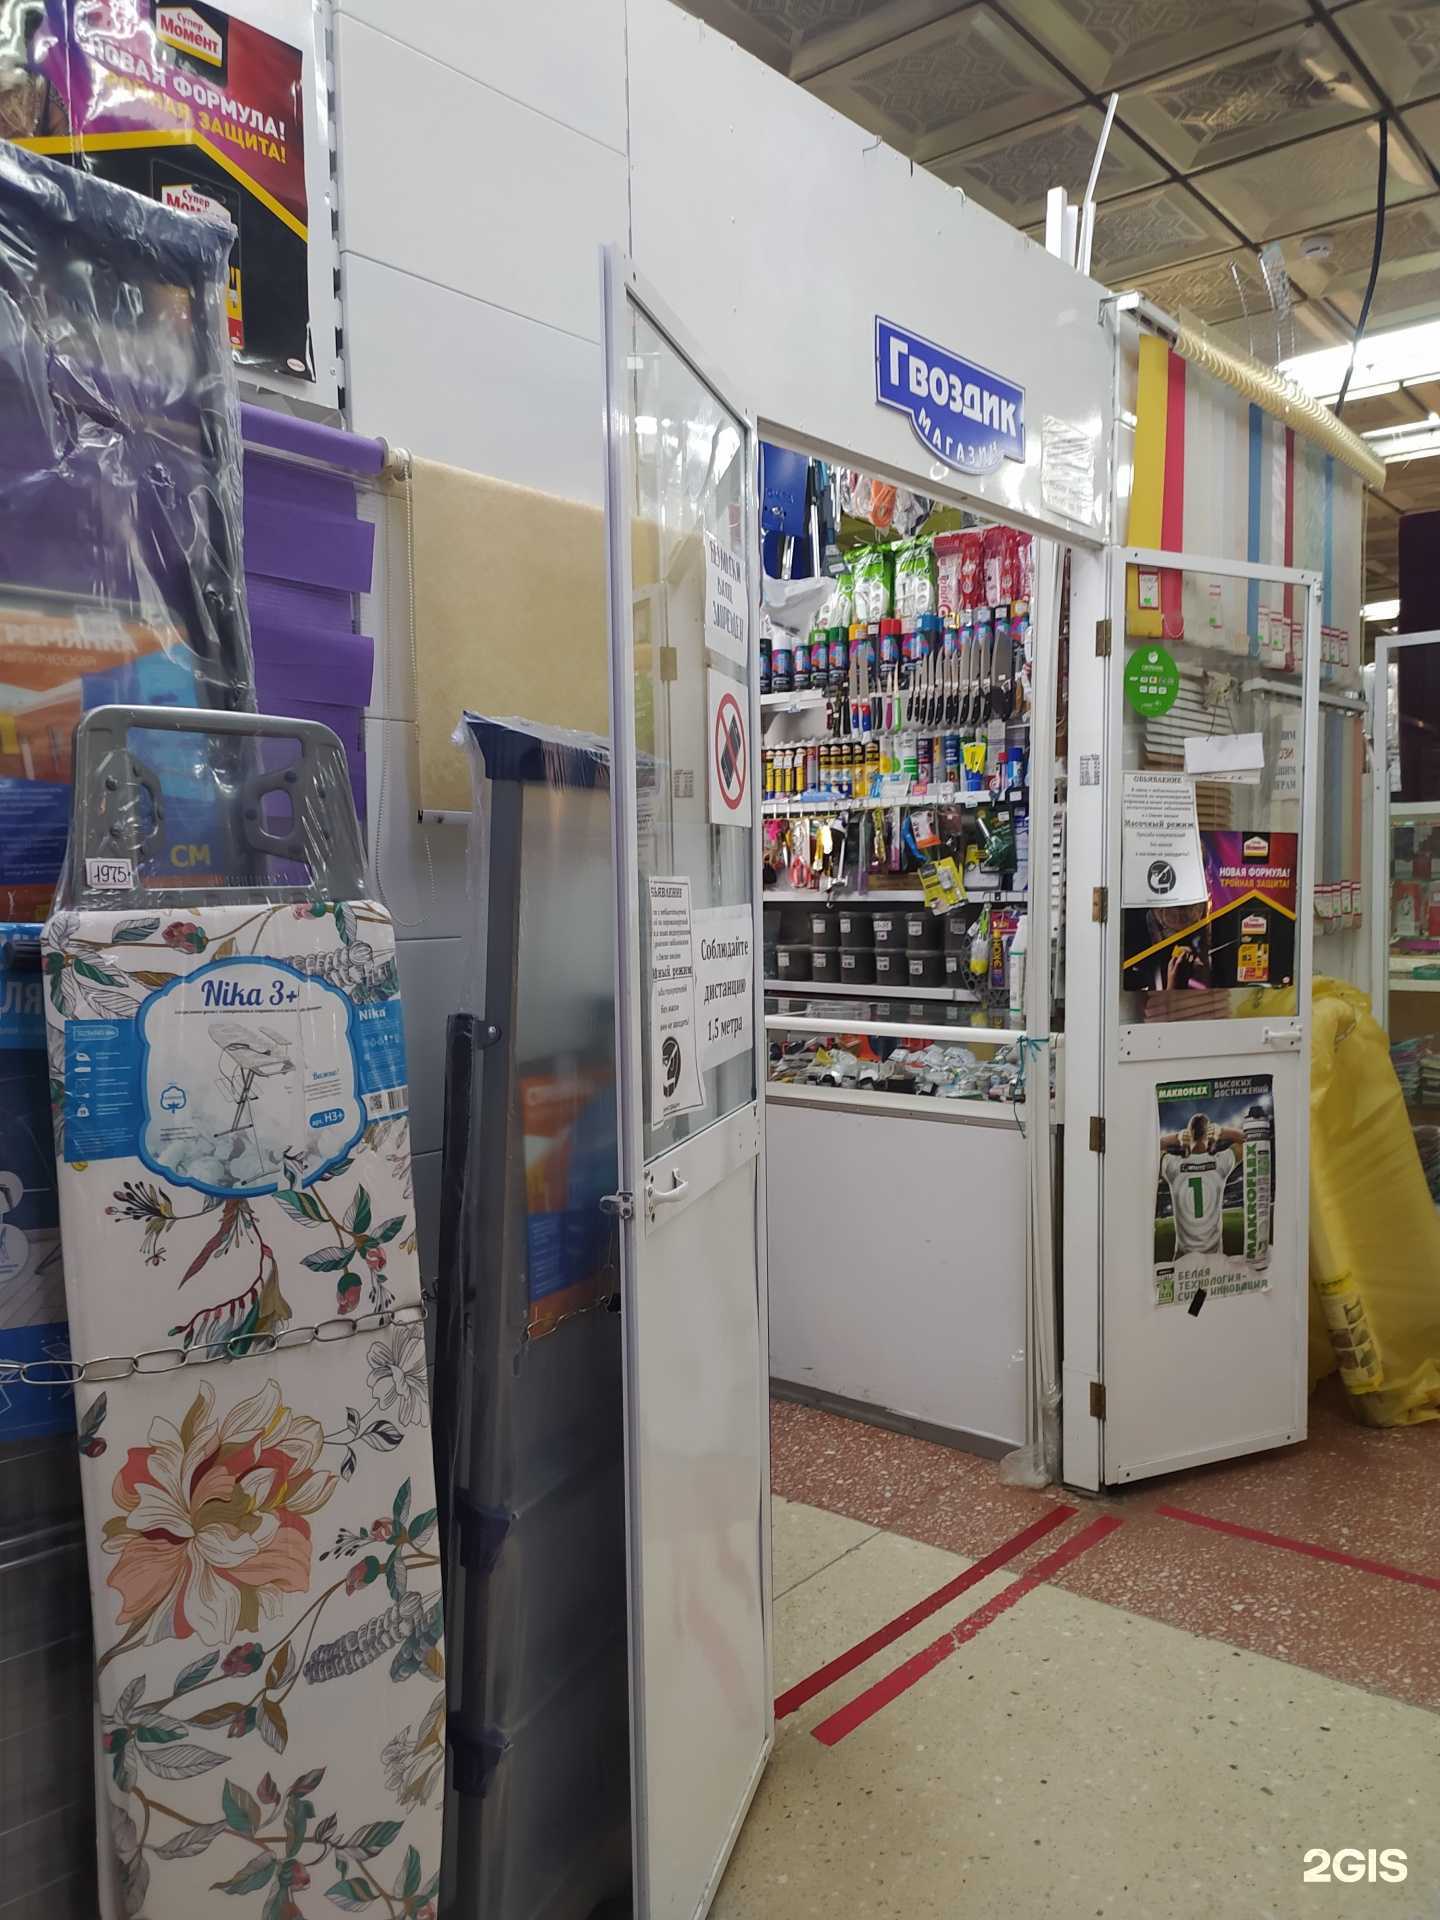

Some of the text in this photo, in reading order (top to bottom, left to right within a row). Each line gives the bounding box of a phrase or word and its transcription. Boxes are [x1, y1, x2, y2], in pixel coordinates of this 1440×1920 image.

[159, 13, 219, 55] Момент
[176, 11, 204, 32] Супер
[172, 75, 287, 141] ФОРМУЛА!
[198, 111, 287, 165] ЗАЩИТА!
[917, 407, 999, 467] МАГАЗИН
[1219, 866, 1290, 878] НОВАЯ ФОРМУЛА!
[1257, 879, 1290, 889] ЗАЩИТА!
[700, 937, 749, 962] Соблюдайте
[201, 979, 298, 1007] Nika 3+
[703, 976, 747, 1004] дистанцию
[358, 1008, 386, 1022] Nika
[707, 1015, 720, 1042] 1,5
[720, 1014, 743, 1040] метра
[1158, 1086, 1208, 1098] MAKROFLEX
[1188, 1176, 1204, 1219] 1
[1246, 1142, 1258, 1259] MAKROFLEX
